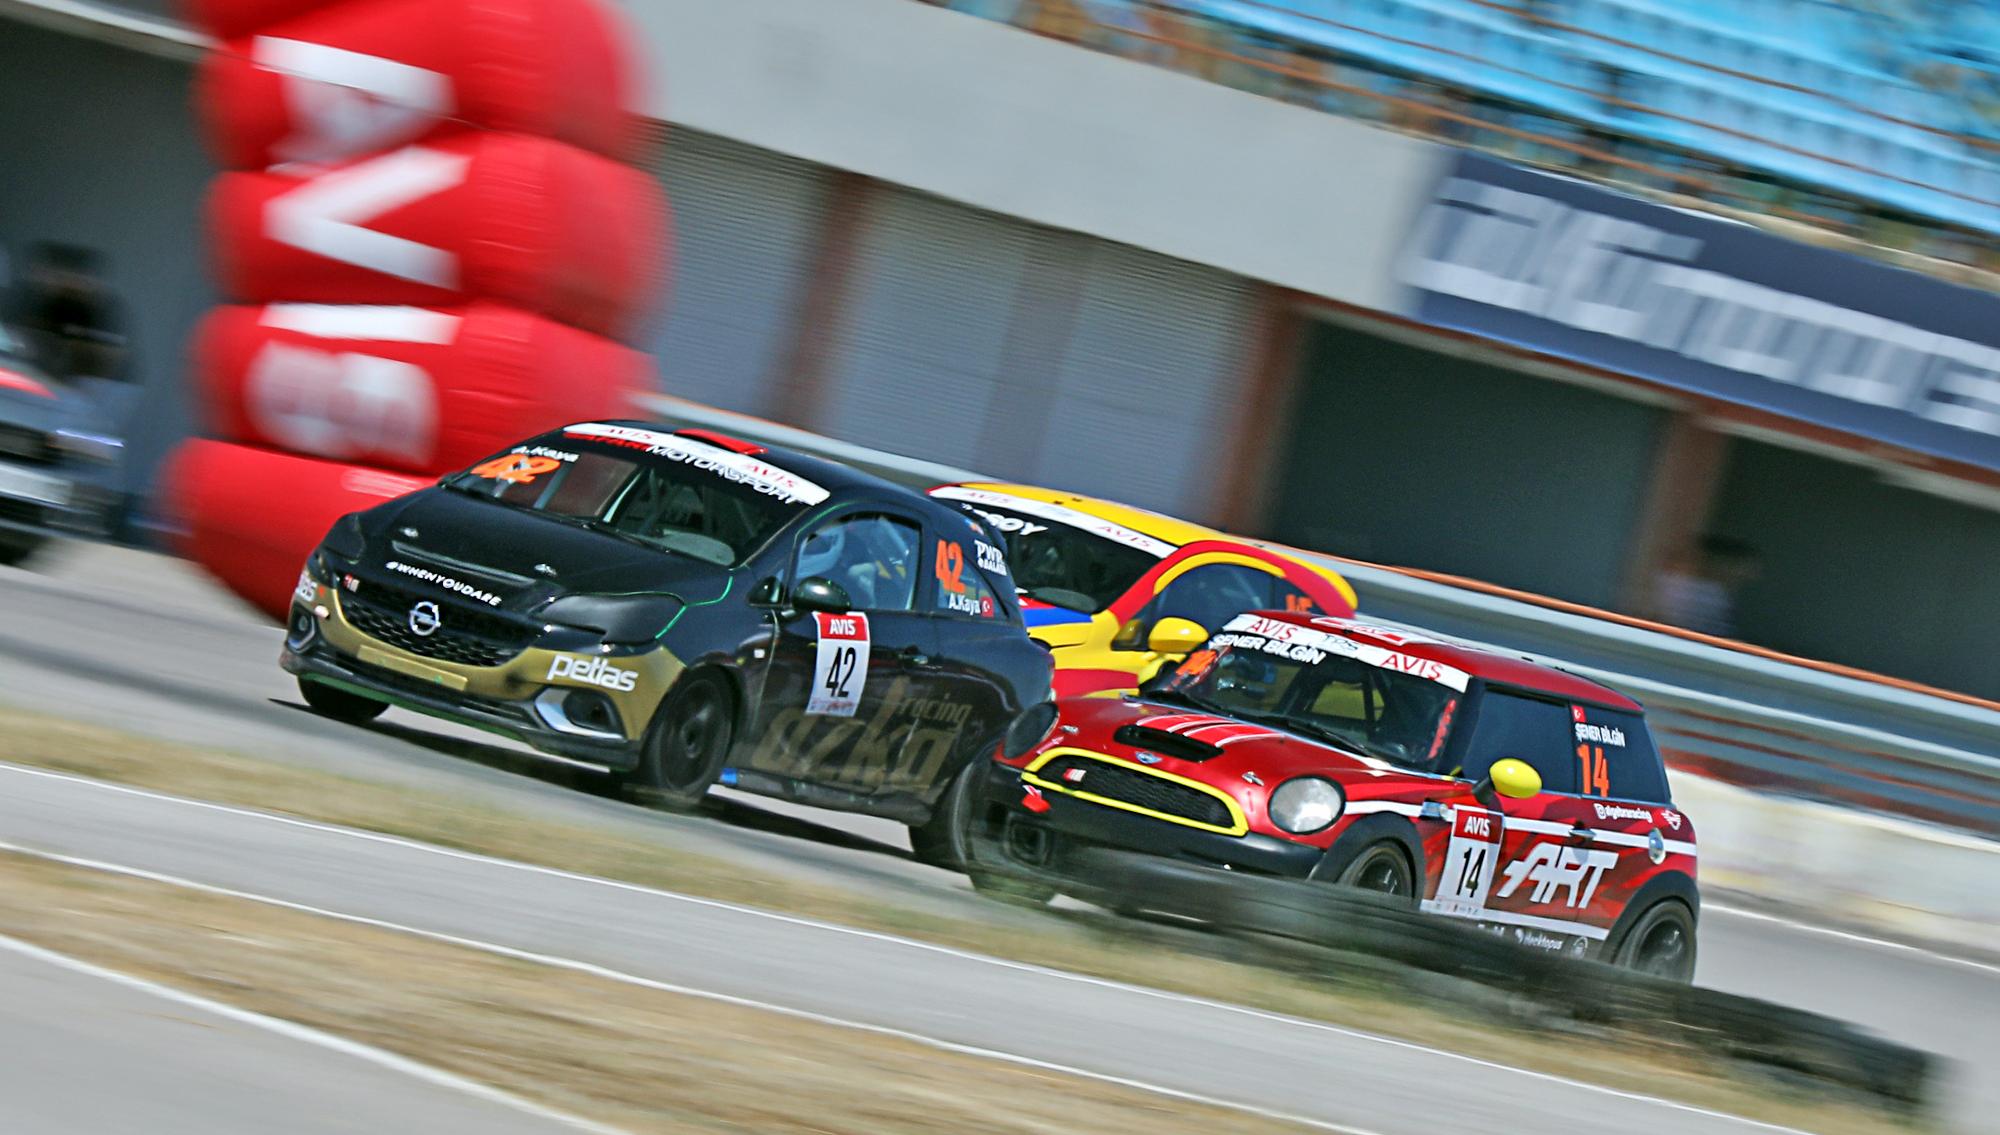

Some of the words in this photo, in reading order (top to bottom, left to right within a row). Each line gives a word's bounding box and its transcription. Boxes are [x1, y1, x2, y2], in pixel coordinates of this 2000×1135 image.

[470, 454, 561, 485] 42
[742, 461, 800, 489] AVIS
[1096, 525, 1151, 548] AVIS
[385, 560, 503, 607] #WHENYOUDARE
[935, 539, 967, 594] 42
[948, 592, 981, 616] A.Kaya
[829, 619, 856, 636] AVIS
[1246, 617, 1298, 641] AVIS
[546, 655, 639, 692] petlas
[826, 647, 856, 697] 42
[1381, 653, 1443, 681] AVIS
[897, 694, 972, 732] racing
[1577, 744, 1610, 798] 14
[1464, 816, 1491, 837] AVIS
[1456, 847, 1487, 898] 14
[1496, 841, 1619, 909] ART
